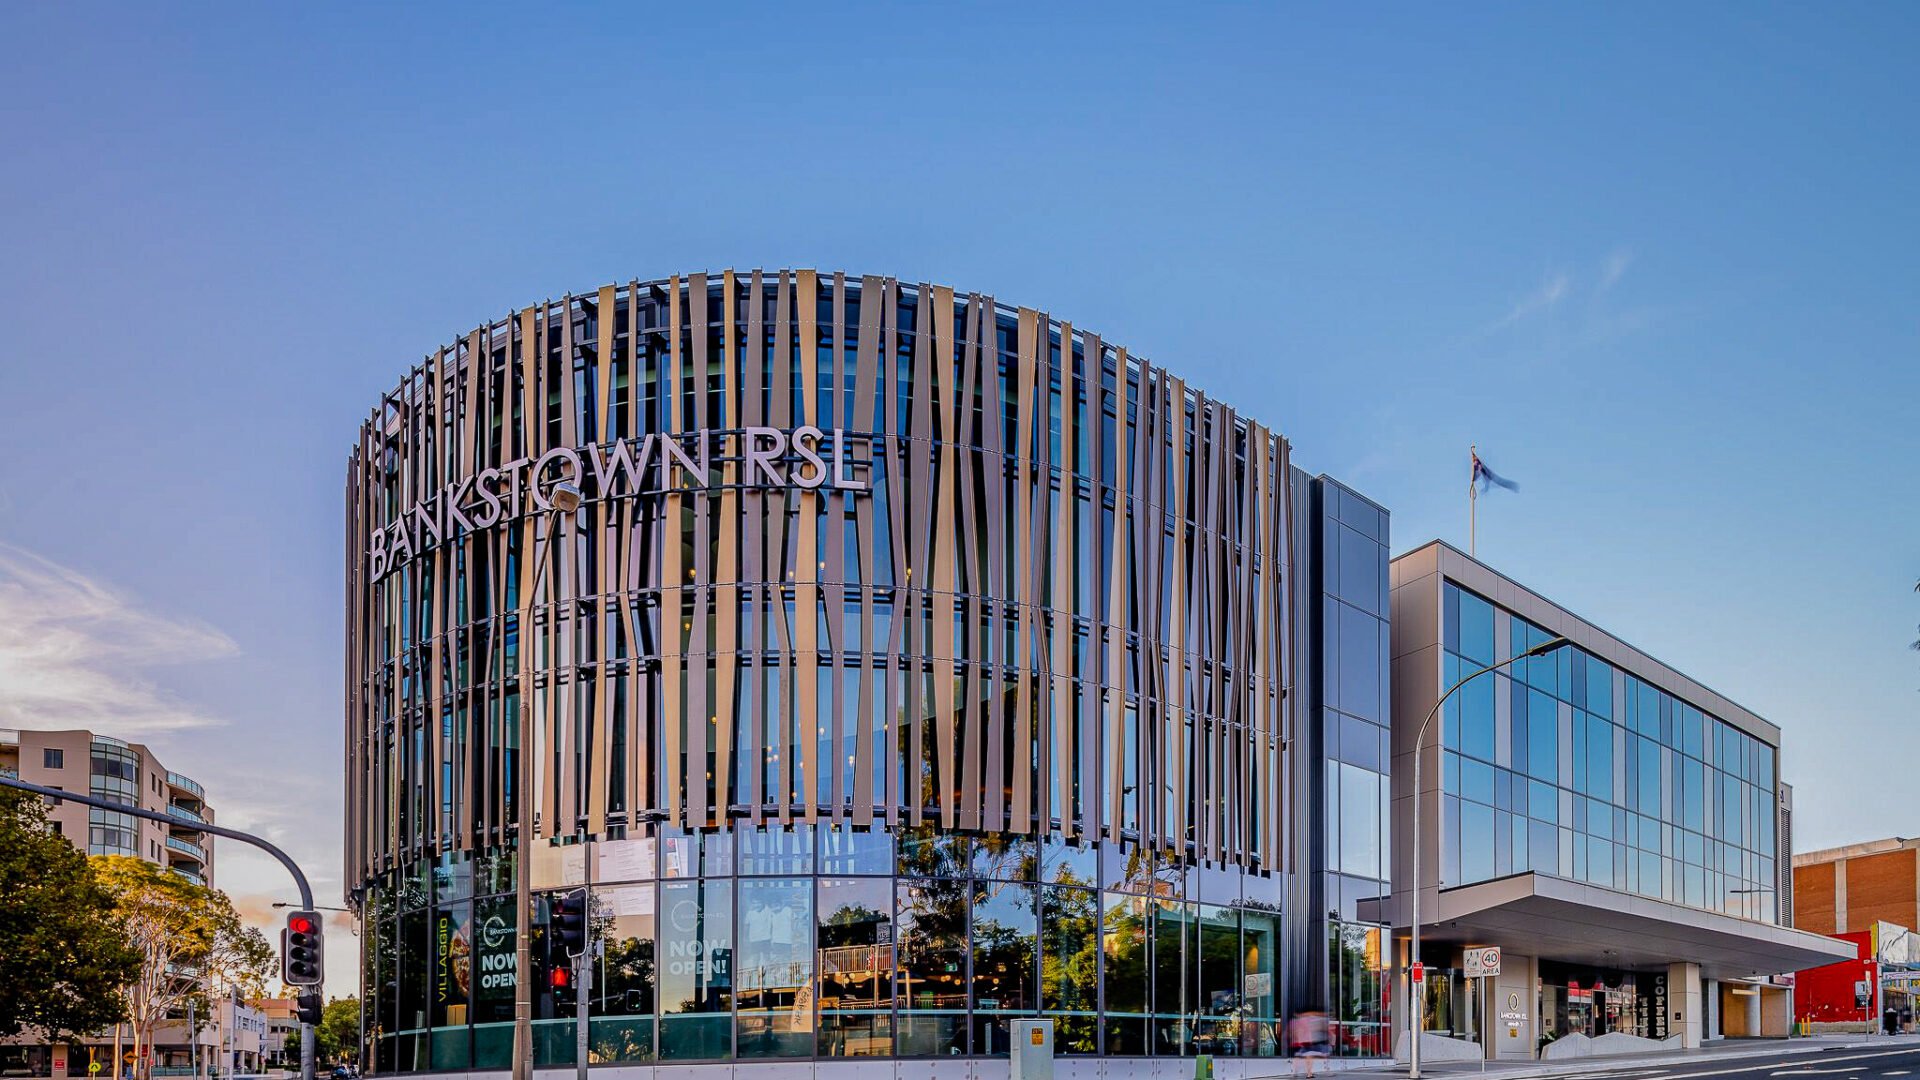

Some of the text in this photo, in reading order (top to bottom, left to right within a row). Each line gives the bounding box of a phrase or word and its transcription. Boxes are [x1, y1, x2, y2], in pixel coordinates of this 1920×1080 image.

[370, 426, 866, 584] BANKSTOWN RSL
[670, 939, 727, 957] NOW
[438, 917, 448, 1002] VILLAGGIO
[482, 953, 518, 971] NOW
[1484, 953, 1498, 963] 40
[670, 960, 727, 975] OPEN!
[1482, 967, 1500, 975] AREA
